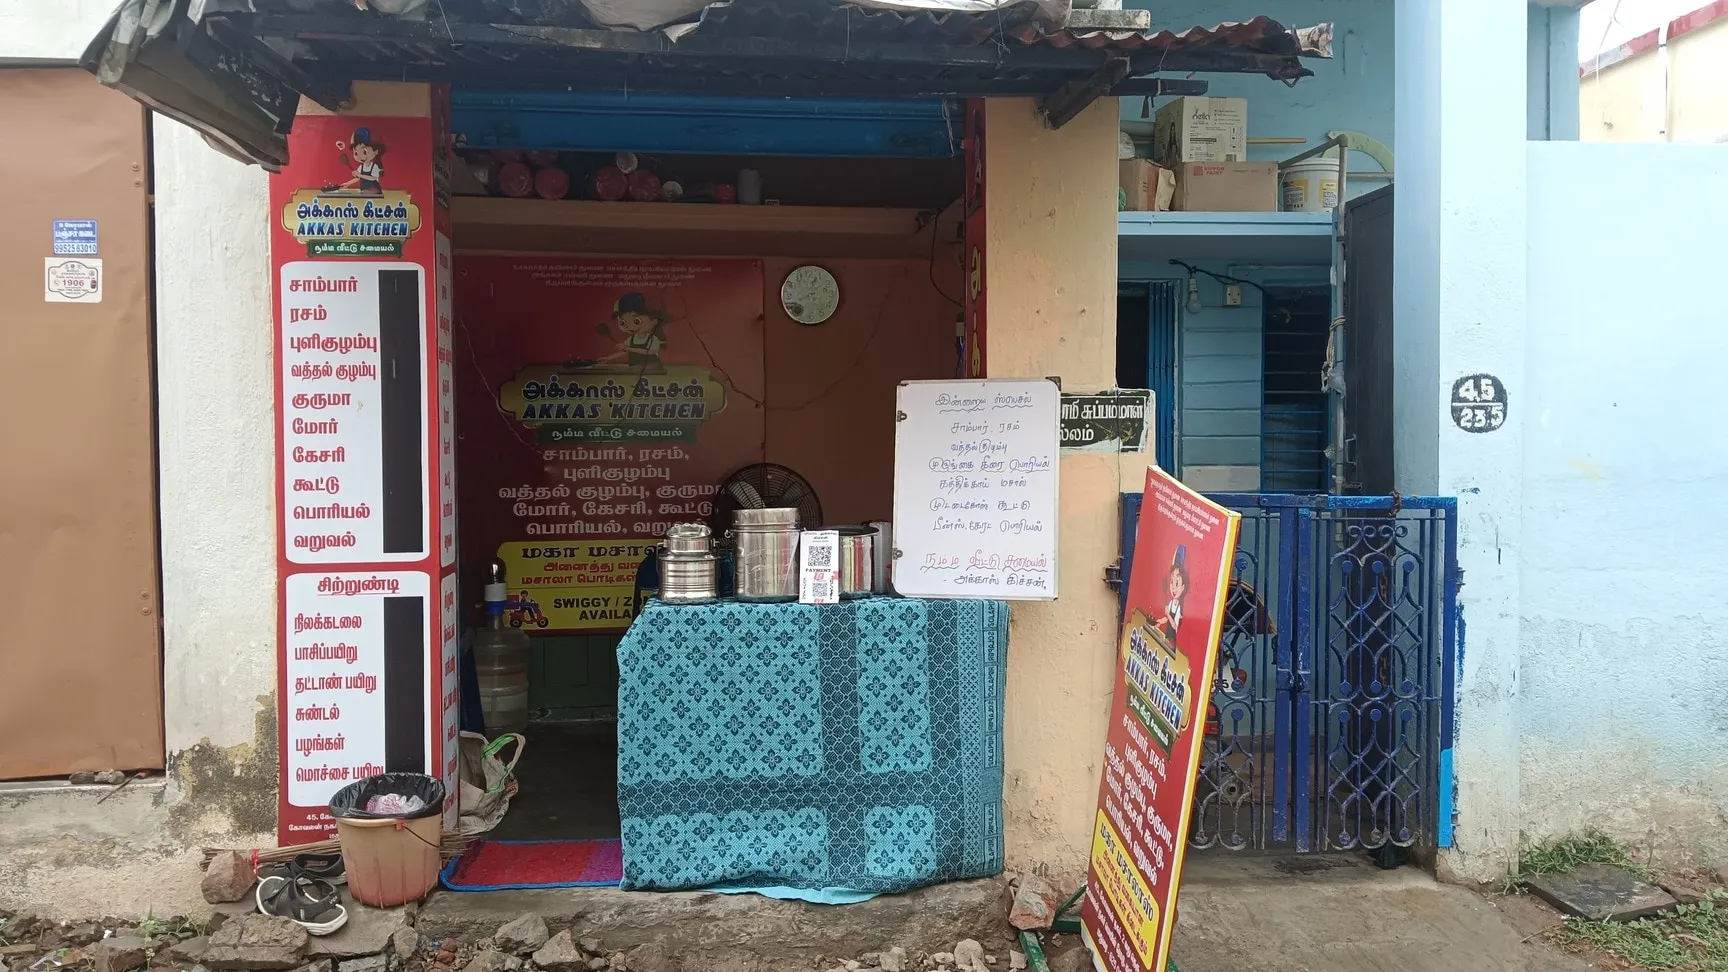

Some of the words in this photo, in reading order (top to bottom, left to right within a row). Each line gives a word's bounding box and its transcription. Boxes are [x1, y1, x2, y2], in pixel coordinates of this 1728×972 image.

[297, 197, 359, 218] அக்காஸ்
[363, 201, 407, 218] கிட்சன்
[297, 223, 345, 236] AKKAS
[350, 223, 408, 236] KITCHEN
[314, 244, 335, 254] நம்ம
[336, 242, 358, 253] வீட்டு
[359, 243, 395, 252] சமையல்
[289, 276, 358, 293] சாம்பார்
[290, 304, 328, 323] ரசம்
[290, 333, 377, 355] புளிகுழம்பு
[291, 361, 333, 382] வத்தல்
[335, 361, 376, 382] குழம்பு
[522, 375, 625, 399] அக்காஸ்
[632, 378, 704, 398] கிட்சன்
[1459, 378, 1496, 402] 45
[292, 393, 352, 409] குருமா
[935, 393, 987, 412] இன்றைய
[994, 391, 1032, 404] ஸ்பெசல்
[1081, 399, 1143, 420] சுப்பம்மாள்
[522, 403, 602, 420] AKKAS
[611, 402, 705, 420] KITCHEN
[1460, 405, 1504, 428] 235
[292, 417, 339, 435] மோர்
[552, 428, 584, 440] நம்ம
[588, 427, 622, 440] வீட்டு
[626, 428, 683, 438] சமையல்
[999, 420, 1020, 433] ரசம்
[1060, 423, 1094, 441] ல்லம்
[292, 446, 345, 463] கேசரி
[542, 446, 633, 462] சாம்பார்,
[639, 446, 690, 462] ரசம்,
[929, 457, 974, 471] முருங்கை
[980, 455, 1005, 471] கீரை
[1009, 456, 1050, 473] பொரியல்
[563, 465, 670, 482] புளிகுழம்பு
[1000, 476, 1027, 487] மசால்
[293, 476, 340, 495] கூட்டு
[498, 484, 570, 501] வத்தல்
[576, 483, 650, 501] குழம்பு,
[293, 503, 370, 520] பொரியல்
[513, 502, 577, 517] மோர்,
[582, 501, 653, 516] கேசரி,
[997, 500, 1031, 511] கூட்டு
[526, 520, 628, 536] பொரியல்,
[1000, 519, 1042, 535] பொரியல்
[294, 531, 356, 552] வறுவல்
[522, 547, 579, 559] மகா
[924, 553, 960, 570] நம்ம
[969, 549, 1001, 570] வீட்டு
[1003, 553, 1047, 568] சமையல்
[543, 560, 615, 573] அனைத்து
[317, 575, 400, 595] சிற்றுண்டி
[521, 576, 573, 585] மசாலா
[953, 573, 1000, 585] அக்காஸ்
[553, 597, 611, 609] SWIGGY
[294, 612, 362, 635] நிலக்கடலை
[579, 609, 632, 621] AVAILA
[295, 642, 358, 664] பாசிப்பயிறு
[1130, 627, 1160, 677] அக்காஸ்
[1160, 656, 1185, 705] கிட்சன்
[295, 672, 342, 696] தட்டாண்
[345, 672, 377, 694] பயிறு
[1126, 655, 1150, 694] AKKAS
[1149, 680, 1182, 731] KITCHEN
[295, 703, 340, 722] சுண்டல்
[295, 732, 345, 757] பழங்கள்
[1123, 714, 1149, 758] சாம்பார்,
[1149, 748, 1167, 782] ரசம்,
[295, 764, 350, 782] மொச்சை
[1125, 743, 1157, 800] புளிகுழம்பு
[1105, 742, 1125, 778] வத்தல்
[1124, 772, 1147, 813] குழம்பு,
[1147, 805, 1173, 853] குருமா,
[1105, 765, 1123, 804] மோர்,
[1123, 792, 1144, 838] கேசரி,
[1144, 829, 1164, 870] கூட்டு,
[1105, 794, 1133, 849] பொரியல்,
[1133, 840, 1158, 886] வறுவல்
[1100, 822, 1117, 855] மகா
[1116, 850, 1154, 921] மசாலாஸ்
